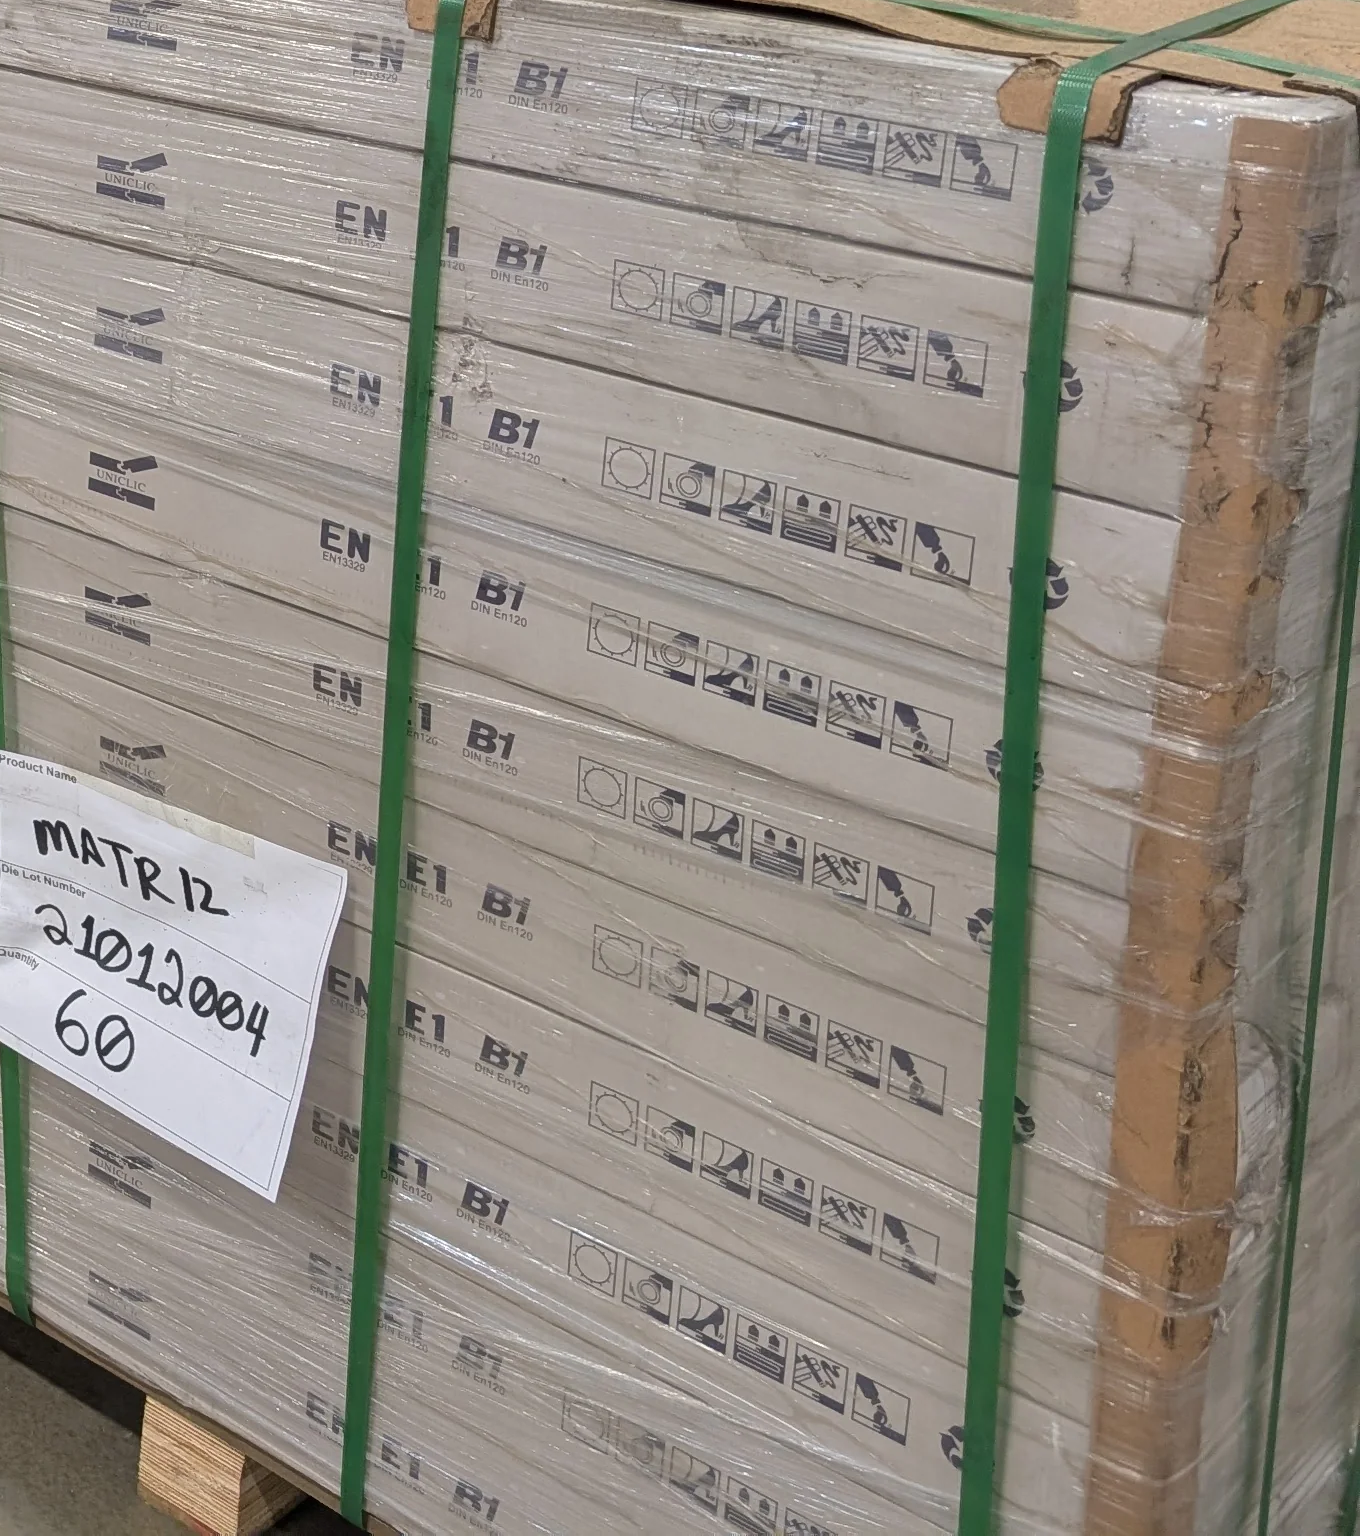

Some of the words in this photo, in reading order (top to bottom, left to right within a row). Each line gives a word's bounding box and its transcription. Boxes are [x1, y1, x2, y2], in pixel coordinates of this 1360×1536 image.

[513, 60, 569, 100] B1
[508, 93, 530, 108] DIN
[533, 96, 569, 116] En120
[103, 171, 157, 194] UNICLIC
[335, 200, 388, 243] EN
[496, 236, 548, 276] B1
[490, 268, 511, 284] DIN
[514, 273, 550, 293] En120
[329, 363, 382, 408] EN
[488, 408, 541, 449] B1
[95, 467, 148, 493] UNICLIC
[320, 518, 370, 563] EN
[475, 570, 527, 613] B1
[322, 551, 366, 573] EN13329
[471, 600, 492, 616] DIN
[494, 606, 528, 628] En120
[312, 663, 363, 709] EN
[466, 718, 516, 761] B1
[45, 764, 78, 784] Name
[106, 750, 157, 781] UNICLIC
[462, 747, 483, 764] DIN
[484, 755, 519, 777] En120
[0, 862, 21, 877] Die
[22, 867, 42, 883] Lot
[43, 871, 87, 899] Number
[327, 820, 377, 866] EN
[405, 850, 448, 895] E1
[481, 882, 532, 927] B1
[399, 878, 419, 895] DIN
[421, 884, 453, 909] En120
[477, 909, 497, 927] DIN
[499, 918, 534, 942] En120
[34, 902, 270, 1058] 21012004
[54, 988, 136, 1073] 60
[404, 999, 445, 1043] E1
[419, 1034, 452, 1058] En120
[479, 1034, 528, 1078] B1
[474, 1061, 495, 1079] DIN
[498, 1069, 531, 1095] En120
[95, 1158, 143, 1189] UNICLIC
[380, 1168, 400, 1188] DIN
[401, 1177, 434, 1204] En120
[387, 1143, 430, 1191] E1
[461, 1180, 510, 1227] B1
